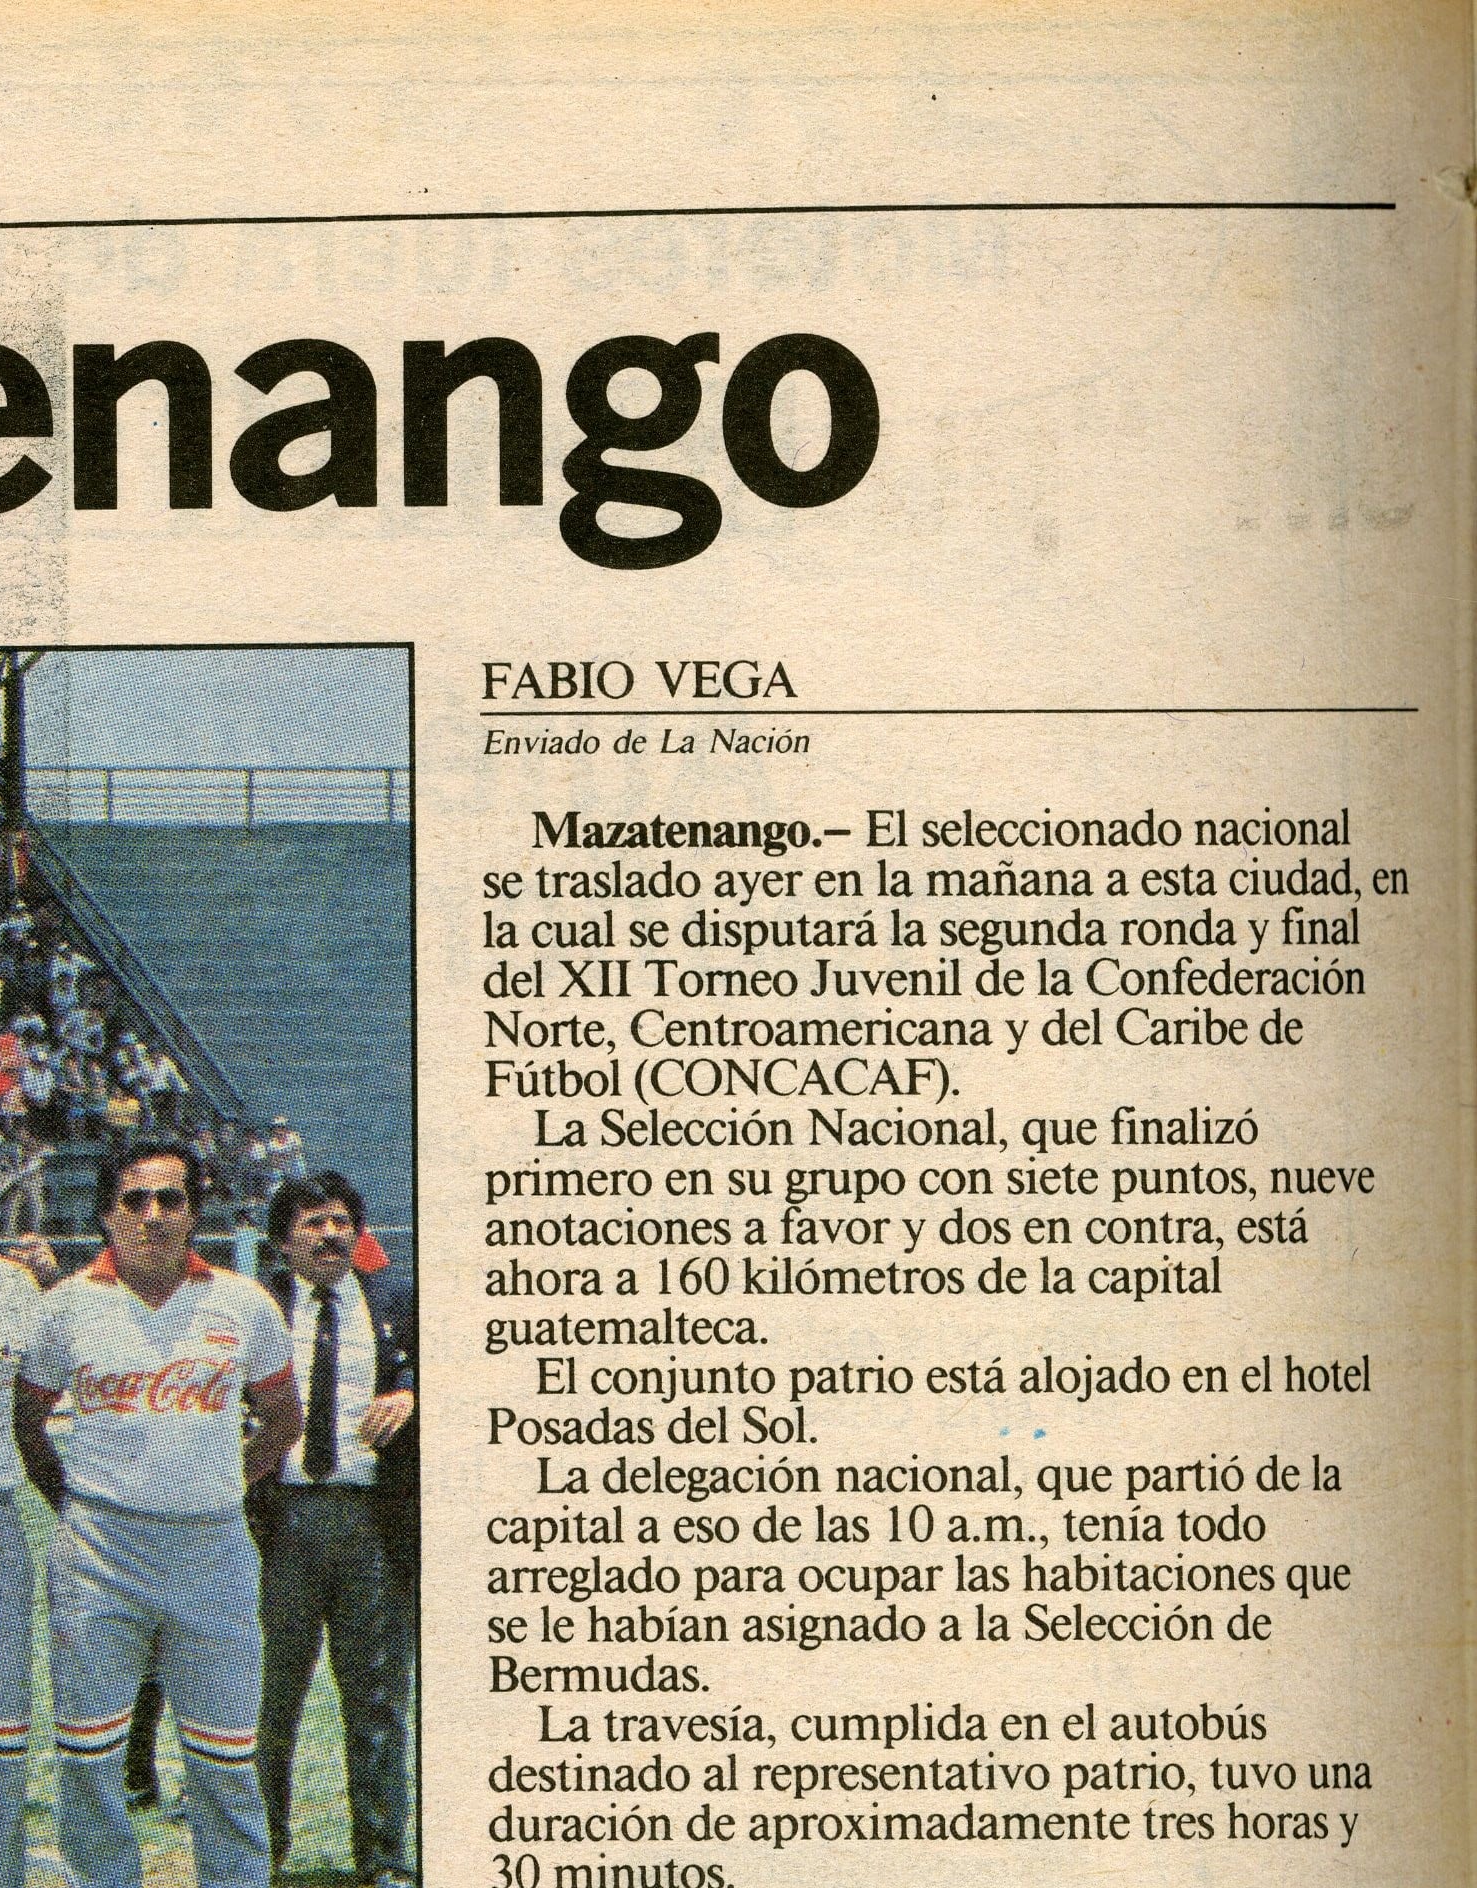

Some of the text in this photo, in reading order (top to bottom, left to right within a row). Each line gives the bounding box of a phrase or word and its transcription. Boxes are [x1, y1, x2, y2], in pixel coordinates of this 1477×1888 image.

[482, 660, 798, 699] FABIO VEGA
[484, 729, 809, 754] Enviado de La Nación
[867, 810, 907, 846] El
[923, 809, 1181, 847] seleccionado
[1195, 808, 1350, 846] nacional
[485, 1058, 959, 1105] Fútbol (CONCACAF).
[535, 1106, 1258, 1153] La Selección Nacional, que finalizó
